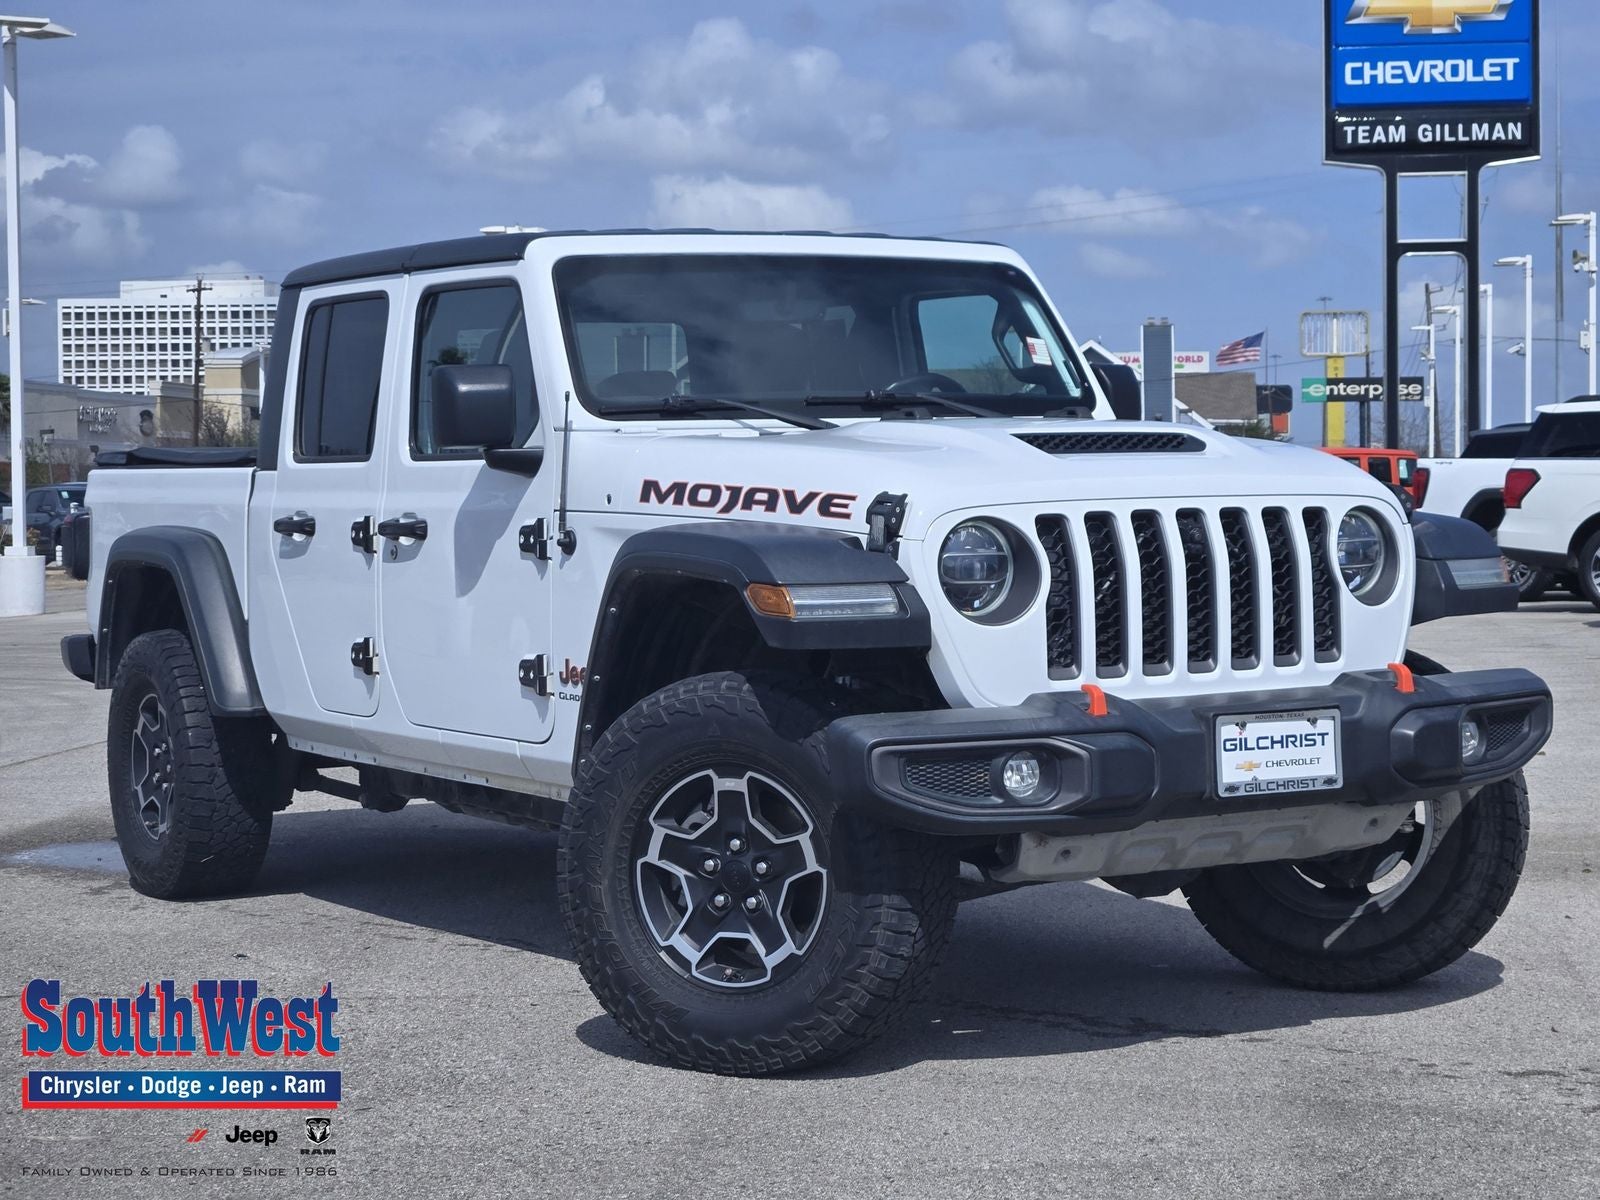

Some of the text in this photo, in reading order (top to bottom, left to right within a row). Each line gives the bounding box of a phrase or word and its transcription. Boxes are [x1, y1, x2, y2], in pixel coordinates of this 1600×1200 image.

[1344, 58, 1520, 85] CHEVROLET
[1344, 122, 1522, 144] TEAM GILLMAN
[1174, 355, 1204, 363] ORLD
[1302, 382, 1422, 398] enterpse
[639, 479, 857, 519] MOJAVE
[559, 658, 588, 686] Jee
[559, 692, 581, 701] GLAD
[1223, 732, 1329, 752] GILCHRIST
[1265, 757, 1321, 768] CHEVROLET
[1244, 778, 1318, 793] GILCHRIST
